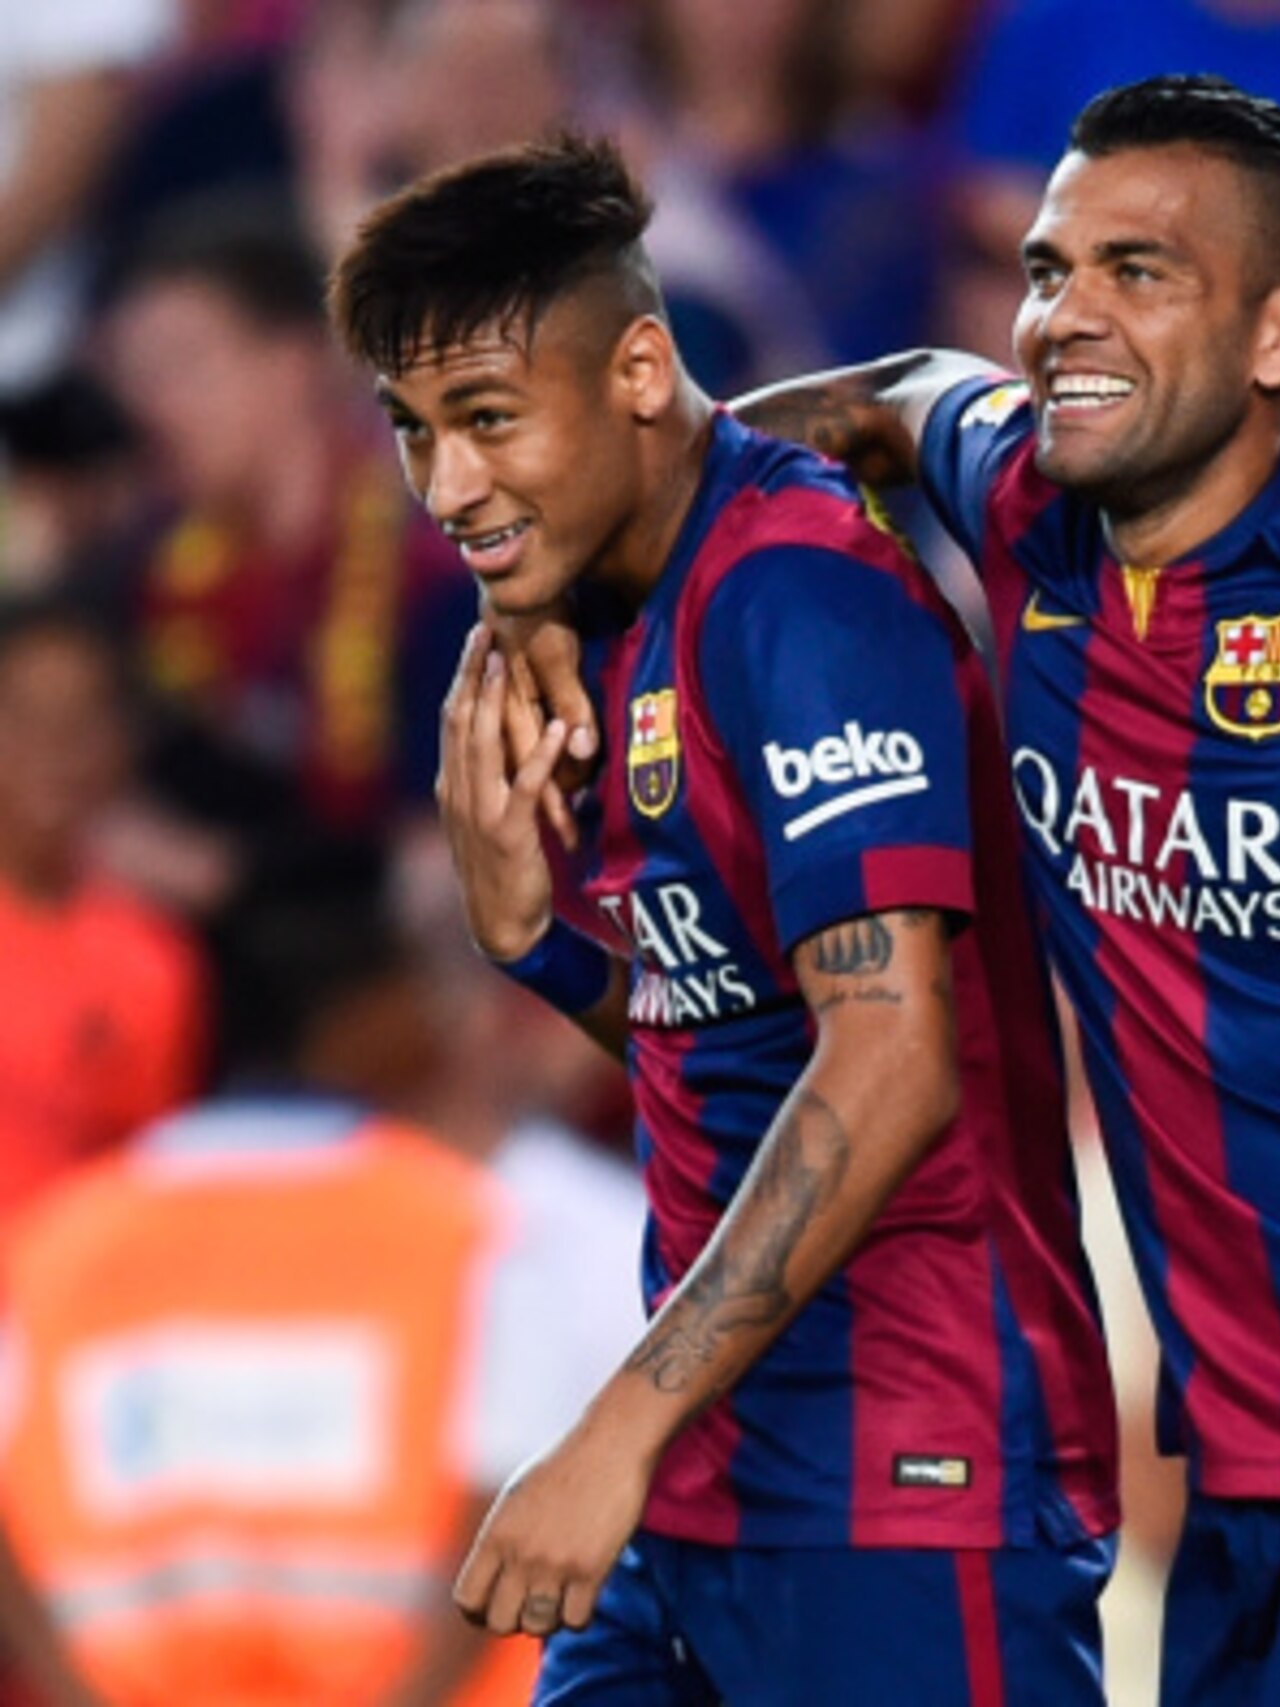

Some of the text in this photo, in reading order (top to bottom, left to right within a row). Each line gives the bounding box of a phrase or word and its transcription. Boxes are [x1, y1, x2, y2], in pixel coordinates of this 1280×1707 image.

[763, 721, 924, 798] beko
[598, 883, 729, 968] TAR
[628, 964, 755, 1026] WAYS
